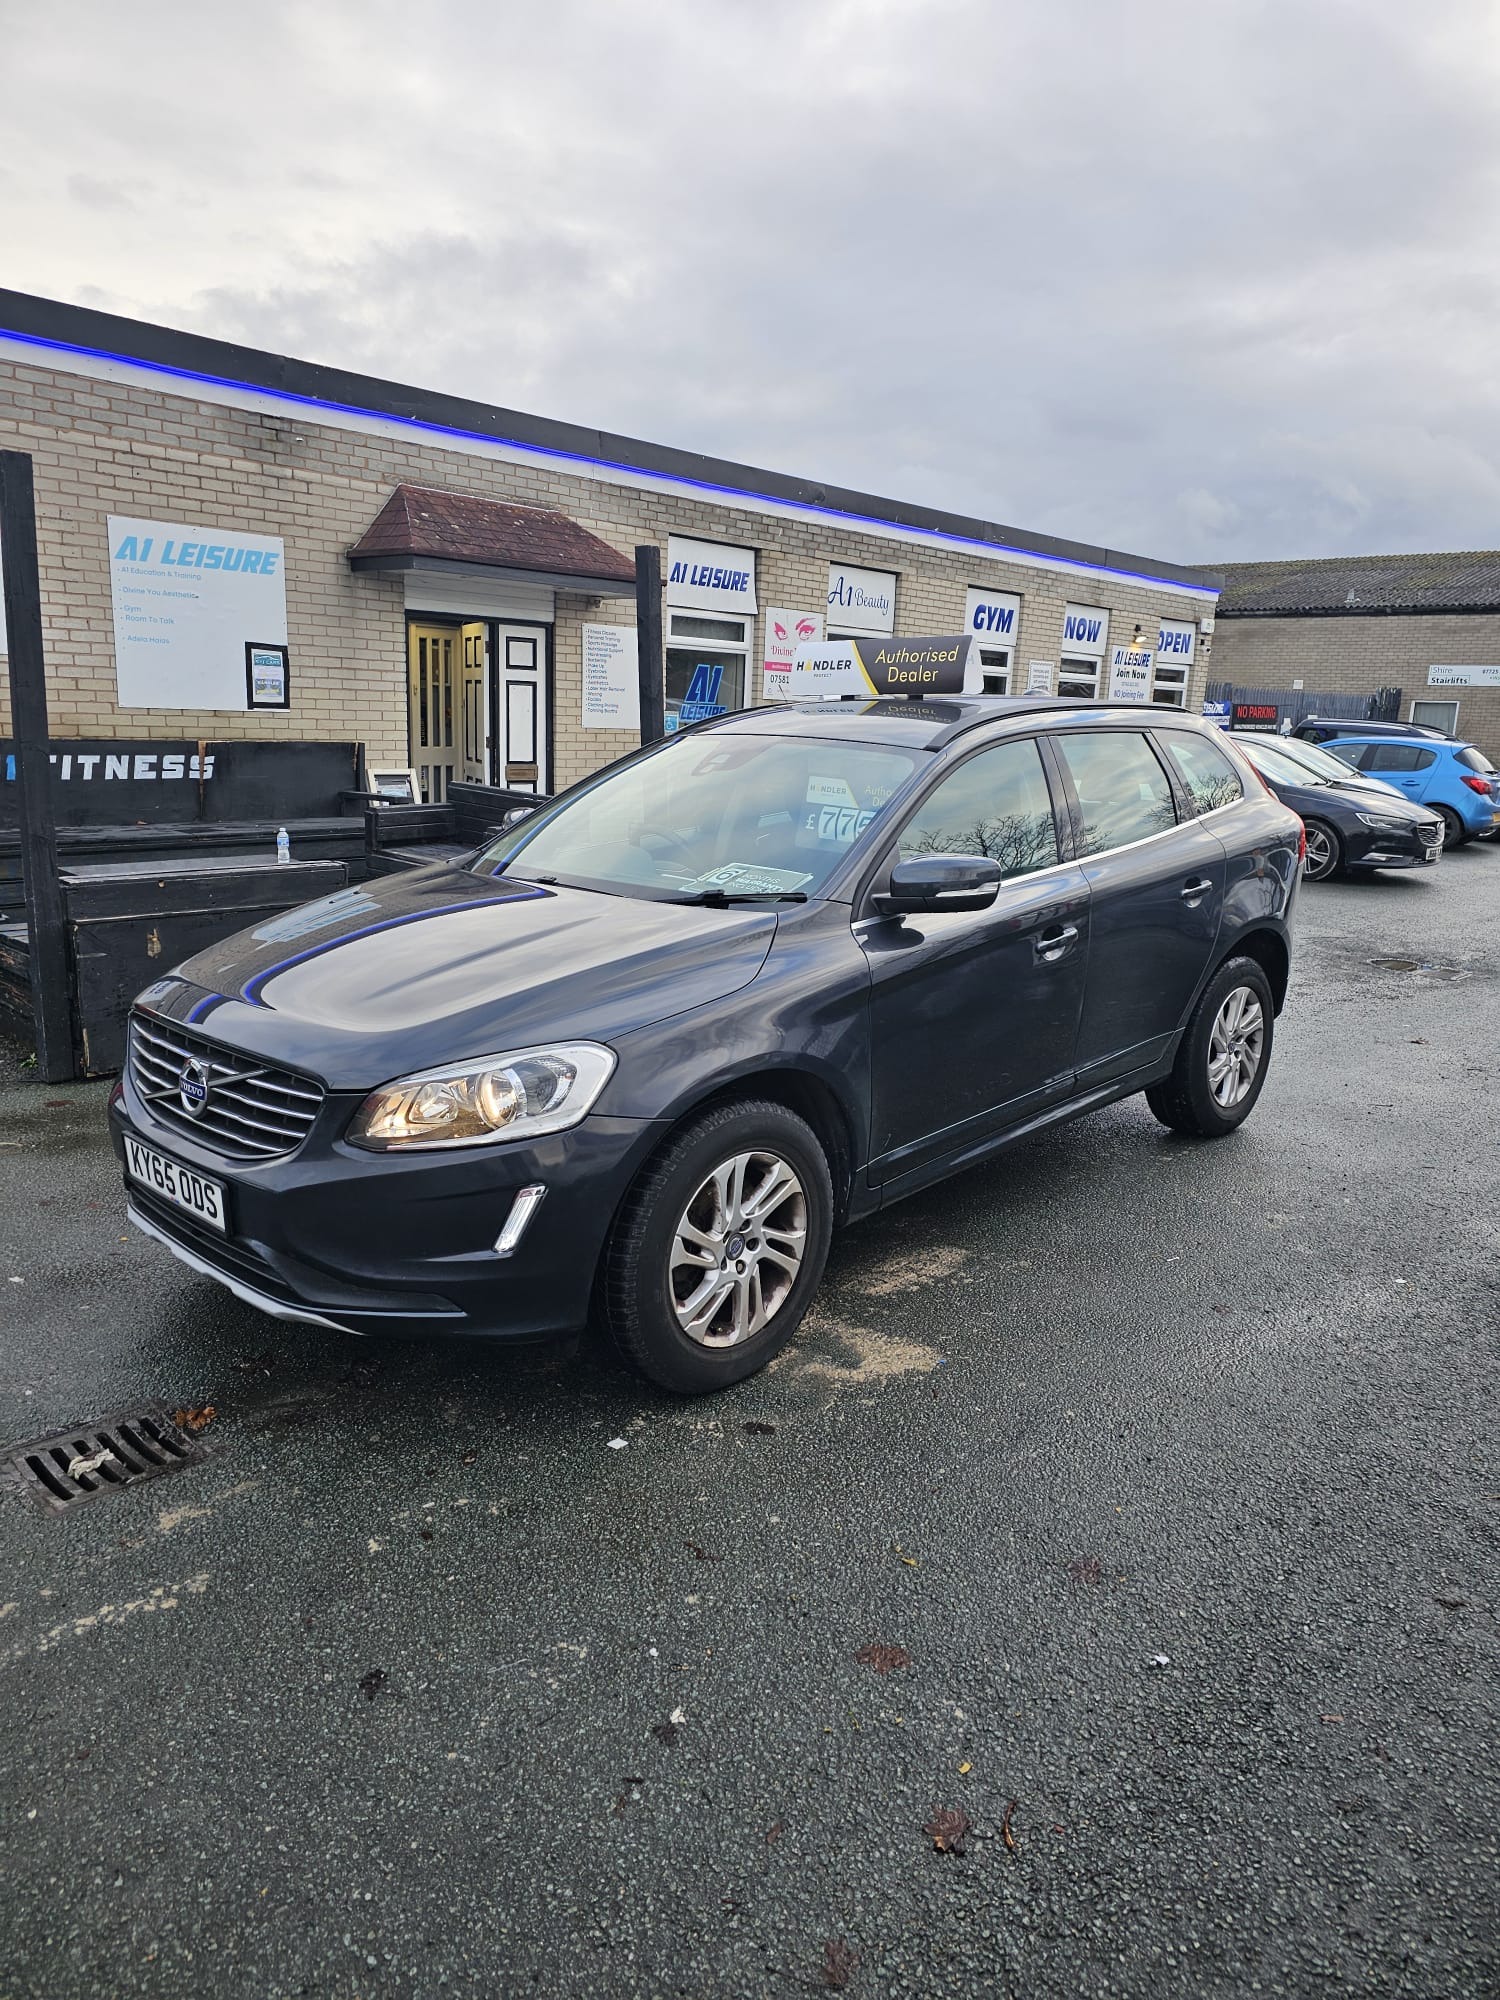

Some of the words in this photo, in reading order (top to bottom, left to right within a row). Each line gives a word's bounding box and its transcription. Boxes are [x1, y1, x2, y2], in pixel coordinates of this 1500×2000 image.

[114, 536, 154, 562] A1
[160, 540, 279, 575] LEISURE
[131, 568, 166, 576] Education
[175, 572, 202, 580] Training
[670, 562, 688, 583] A1
[690, 565, 750, 592] LEISURE
[828, 576, 852, 606] A1
[855, 588, 889, 616] Beauty
[126, 614, 147, 622] Room
[973, 604, 1014, 633] GYM
[1064, 616, 1101, 642] NOW
[771, 645, 793, 656] Divine
[1158, 631, 1191, 653] OPEN
[874, 645, 959, 664] Authorised
[1124, 652, 1151, 667] LEISURE
[797, 660, 851, 671] HANDLER
[887, 666, 938, 682] Dealer
[1116, 668, 1130, 678] Join
[1132, 669, 1146, 679] Now
[684, 664, 724, 704] A1
[770, 675, 790, 684] 07581
[1237, 706, 1247, 718] NO
[1249, 706, 1276, 719] PARKING
[50, 755, 216, 780] ITNESS
[181, 1081, 203, 1096] VOLVO
[130, 1141, 176, 1196] KY65
[179, 1170, 217, 1219] ODS
